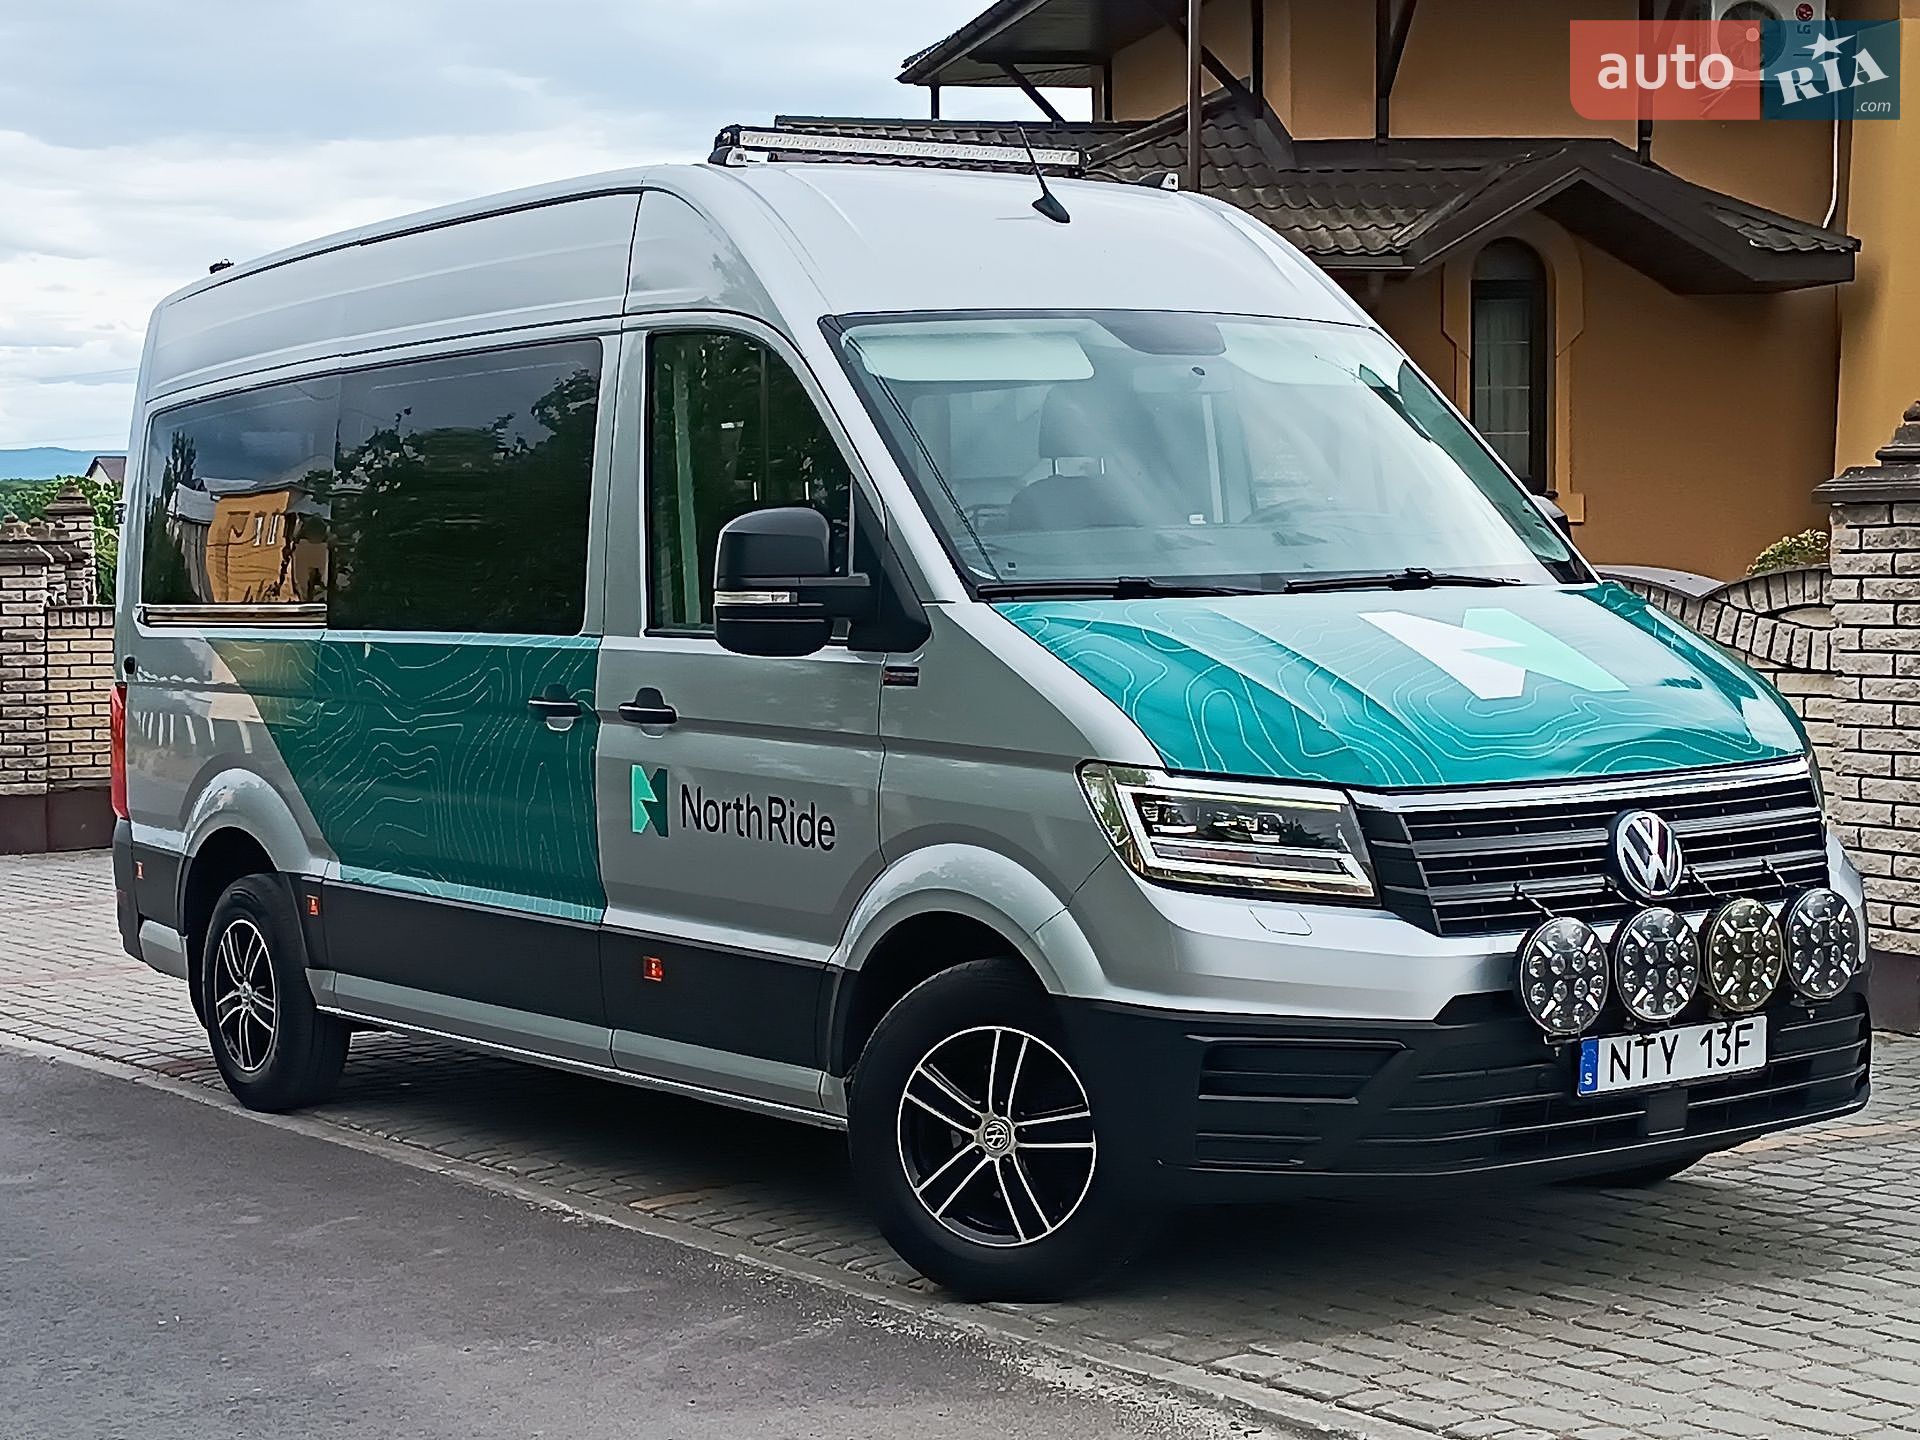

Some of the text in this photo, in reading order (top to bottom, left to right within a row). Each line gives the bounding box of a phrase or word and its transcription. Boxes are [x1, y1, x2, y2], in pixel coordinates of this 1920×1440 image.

[1796, 24, 1811, 35] LG
[1609, 1023, 1753, 1082] NTY 13F
[1584, 1073, 1592, 1084] S
